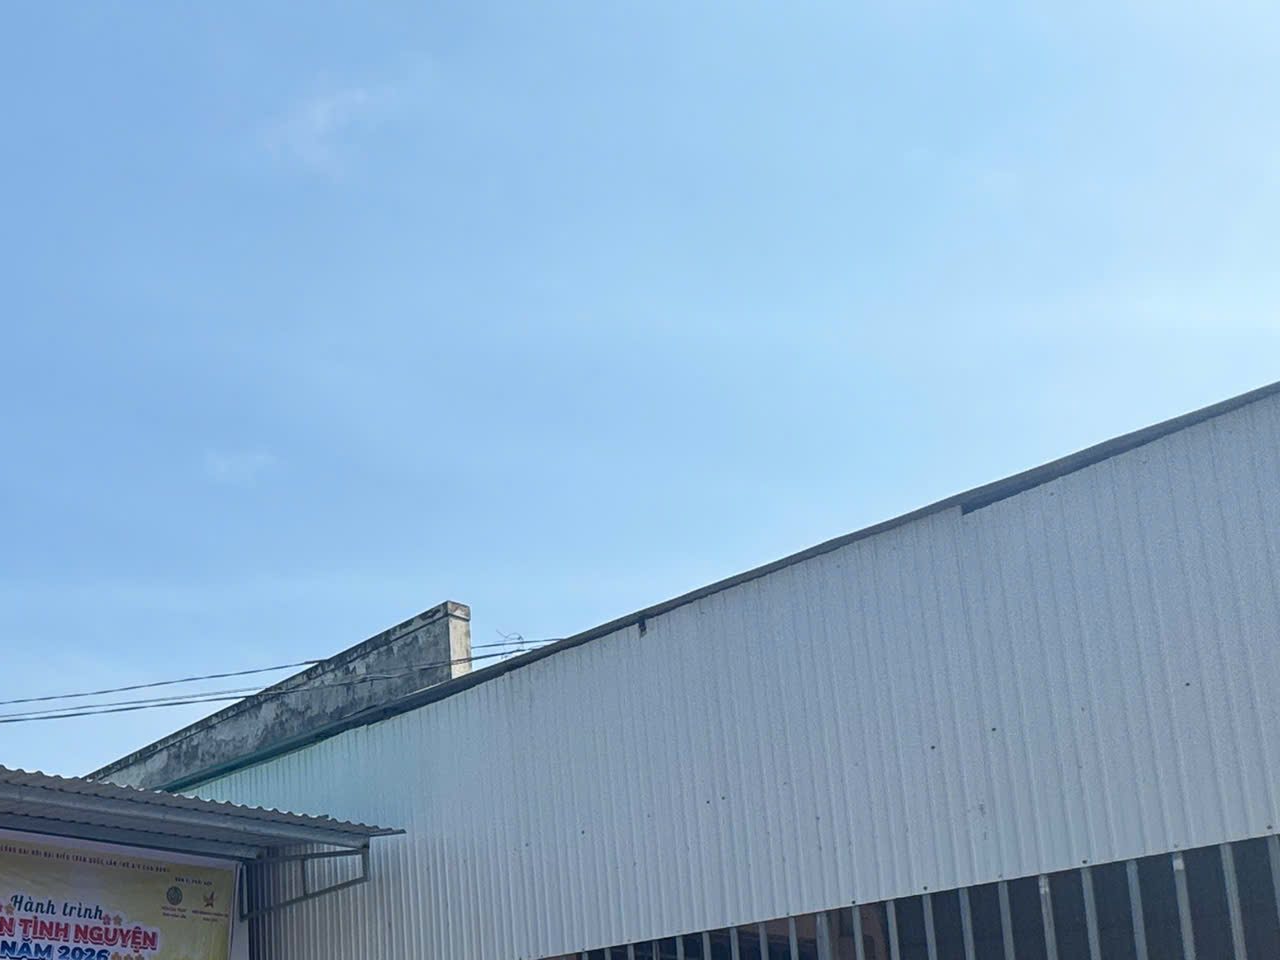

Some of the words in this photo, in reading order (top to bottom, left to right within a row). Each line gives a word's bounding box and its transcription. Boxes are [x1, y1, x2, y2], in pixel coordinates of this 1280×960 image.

[10, 894, 57, 916] Hành
[63, 901, 104, 921] trình
[18, 915, 70, 942] TÌNH
[73, 922, 158, 953] NGUYỆN
